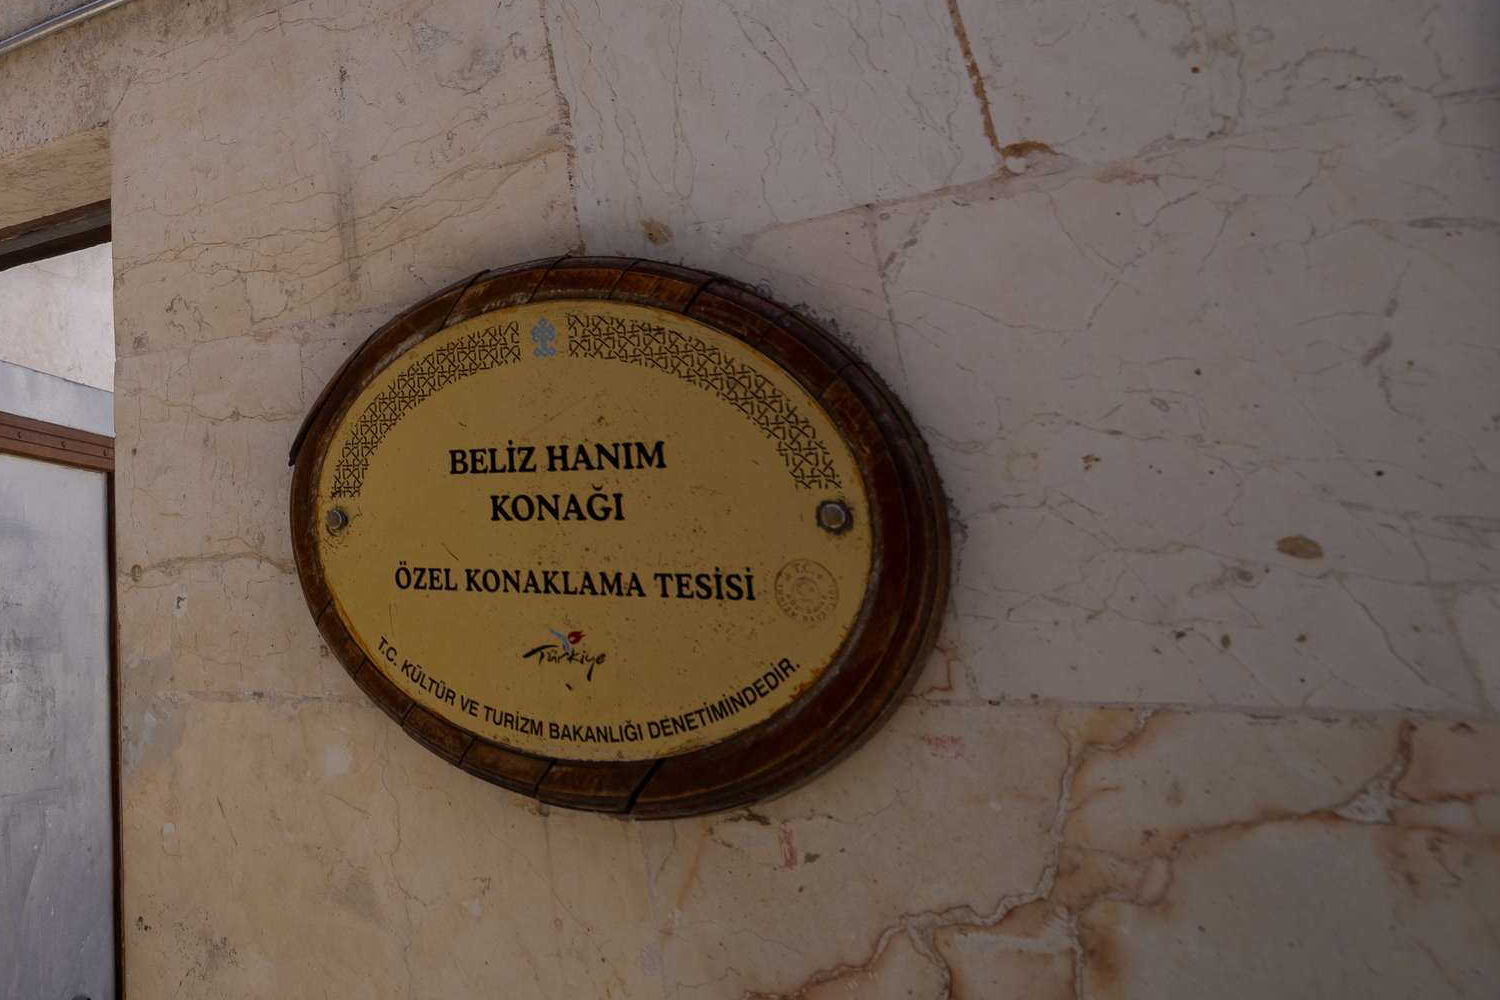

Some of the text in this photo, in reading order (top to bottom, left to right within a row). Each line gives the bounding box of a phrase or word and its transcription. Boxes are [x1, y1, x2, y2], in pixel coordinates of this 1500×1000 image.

[449, 440, 667, 475] BELİZ HANIM
[490, 483, 625, 521] KONAĞI
[394, 561, 458, 591] ÖZEL
[465, 568, 646, 598] KONAKLAMA
[654, 566, 756, 601] TESİSİ
[522, 644, 606, 682] Türkiye
[377, 636, 801, 744] T.C. KÜLTÜR VE TURİZM BAKANLIĞI DENETİMİNDEDİR.
